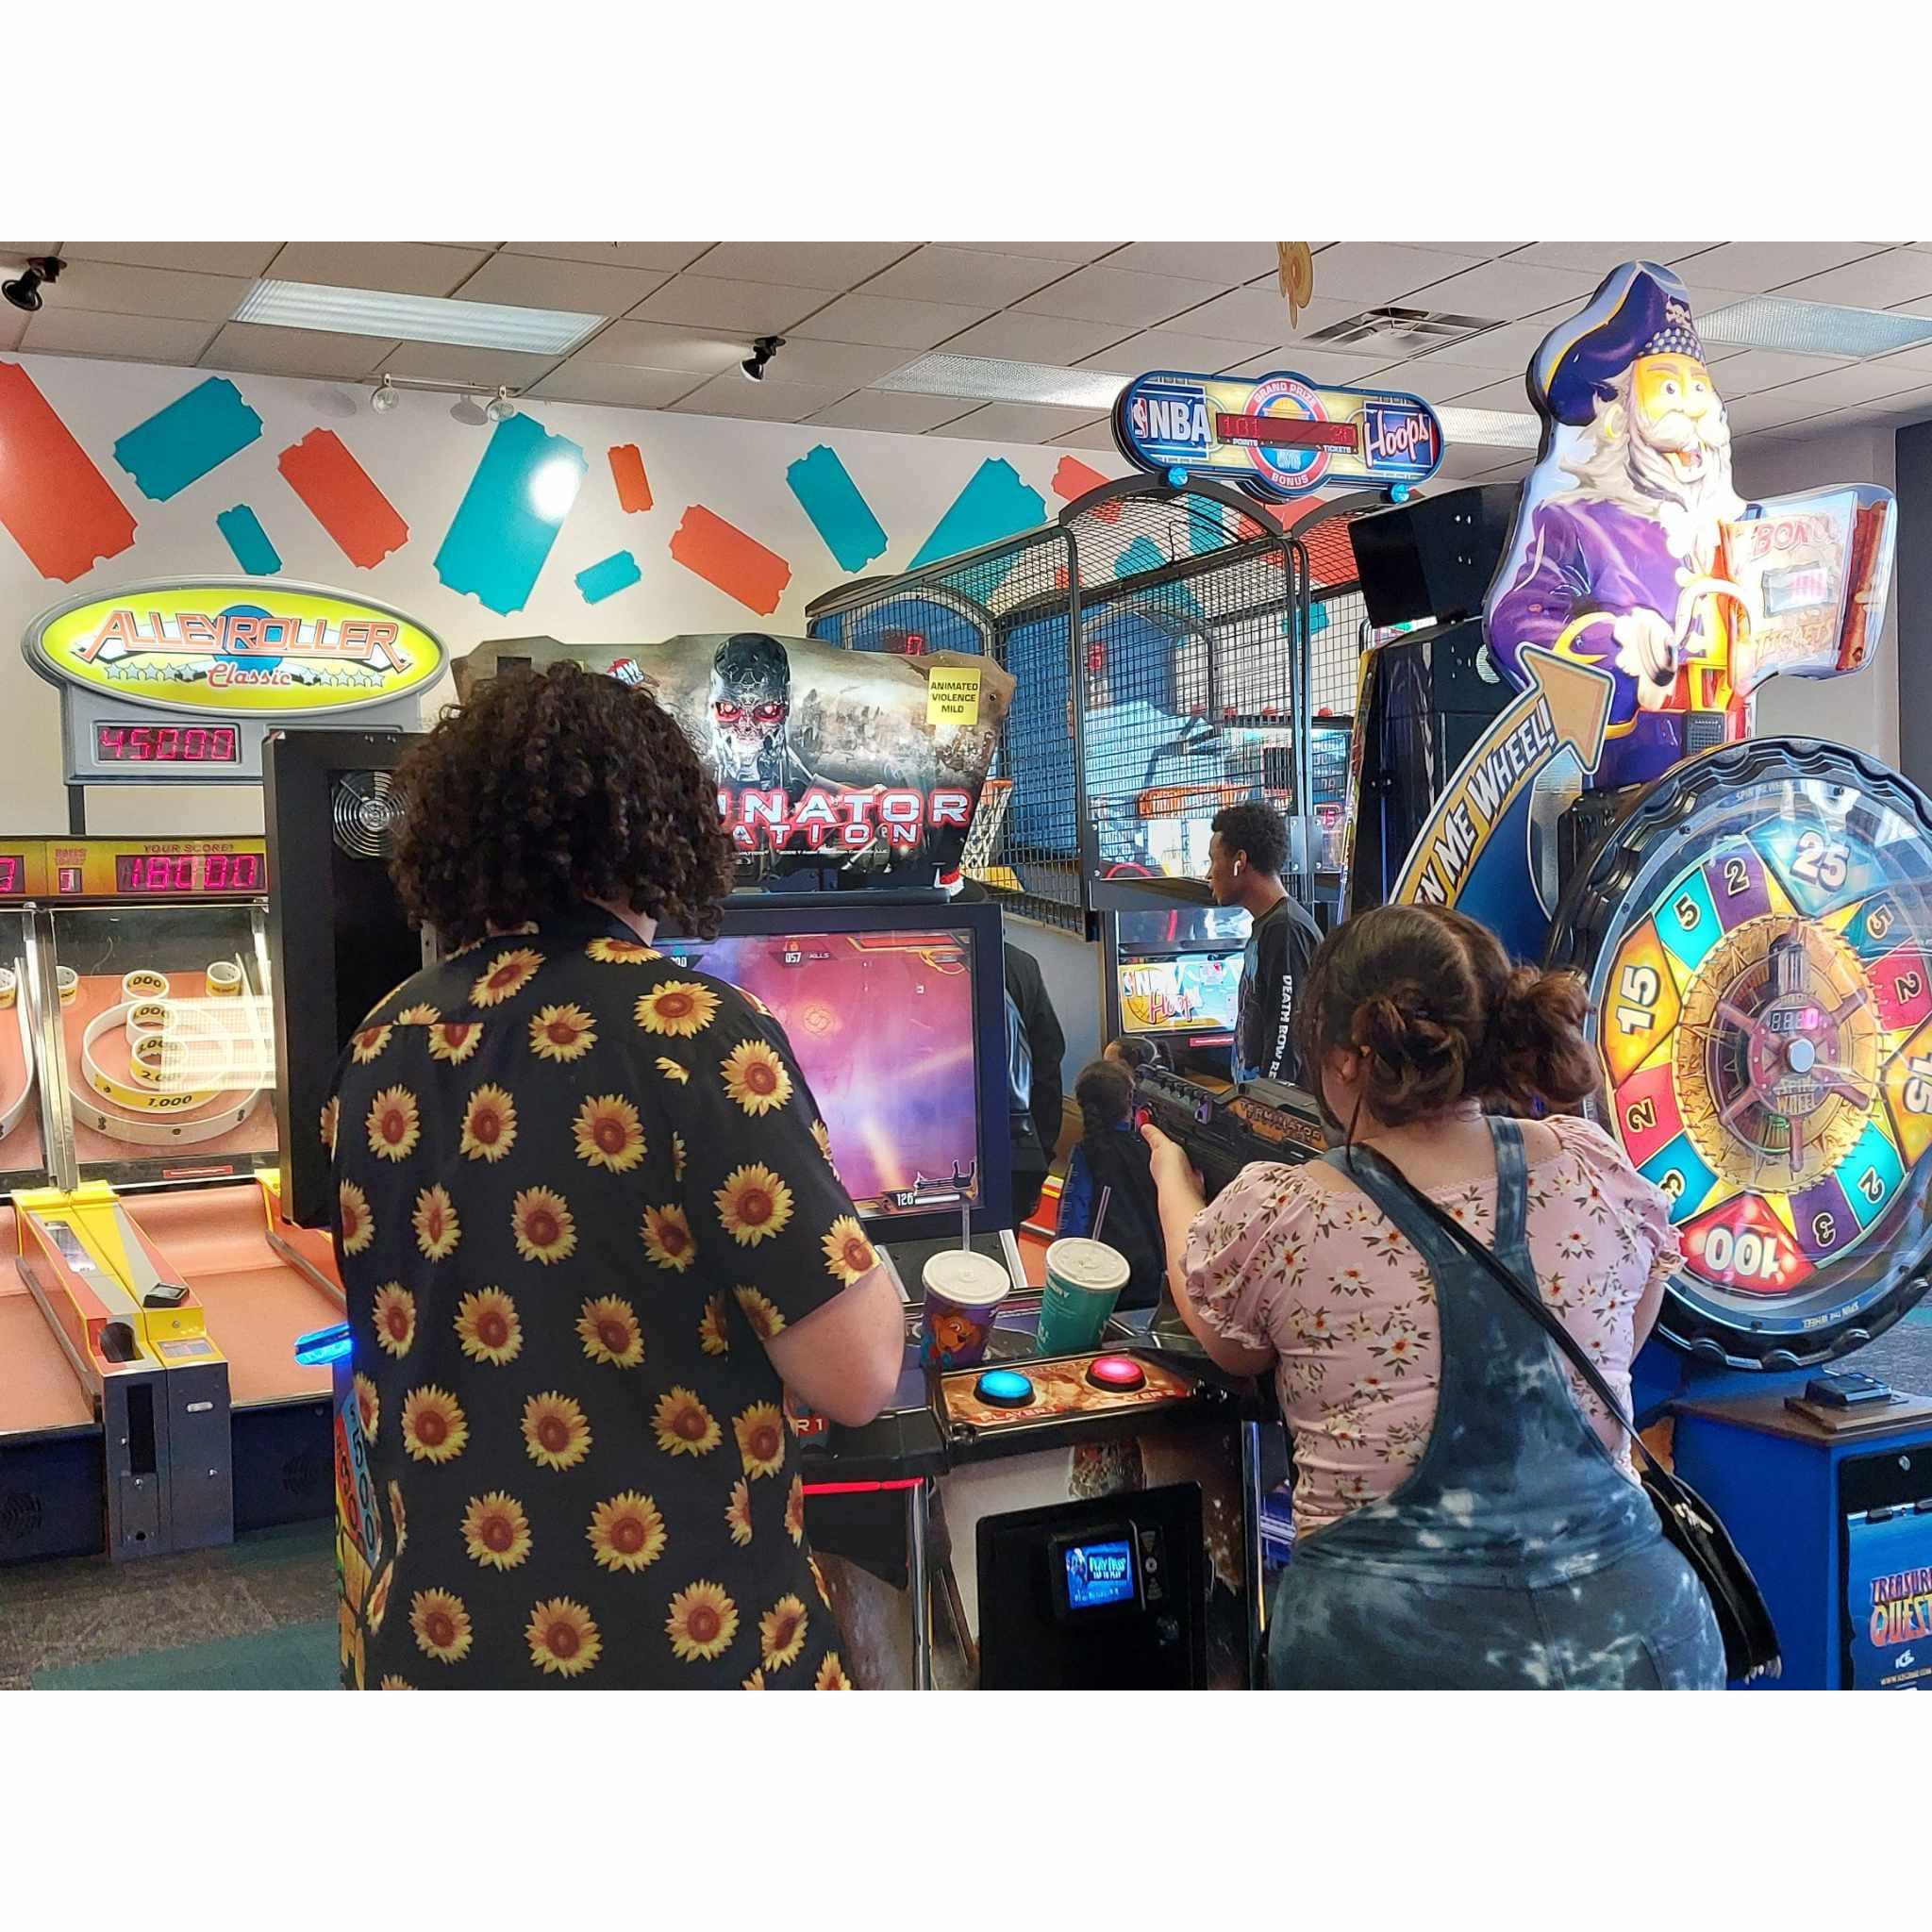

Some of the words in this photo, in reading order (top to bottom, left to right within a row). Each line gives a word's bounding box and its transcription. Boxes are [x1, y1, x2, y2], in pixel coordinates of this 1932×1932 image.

[1290, 383, 1316, 406] PRIZE
[1149, 399, 1212, 443] NBA
[1363, 409, 1430, 468] Hoops
[1272, 472, 1309, 486] BONUS
[207, 662, 291, 688] Classic
[930, 682, 978, 691] ANIMATED
[932, 693, 976, 702] VIOLENCE
[941, 705, 964, 713] MILD
[99, 727, 235, 759] 45000
[1433, 797, 1478, 885] ME
[1466, 692, 1559, 823] WHEEL!
[717, 793, 969, 824] INATOR
[143, 843, 179, 853] YOUR
[184, 843, 234, 853] SCORE!
[732, 824, 917, 844] ATION
[1724, 857, 1751, 896] 2
[1790, 831, 1850, 892] 25
[1672, 894, 1702, 931] 5
[1865, 904, 1895, 940] 5
[1280, 974, 1292, 1023] DEATH
[1616, 965, 1660, 1035] 15
[1894, 972, 1922, 1005] 2
[1274, 1024, 1290, 1062] ROW
[147, 1094, 192, 1108] 1,000
[1626, 1098, 1657, 1130] 2
[896, 1191, 914, 1207] 126
[1658, 1168, 1687, 1199] 3
[1859, 1166, 1887, 1205] 2
[1811, 1211, 1837, 1247] 3
[1704, 1227, 1780, 1279] 100
[979, 1407, 1047, 1422] PLAYER
[1872, 1569, 1932, 1606] TREASUR
